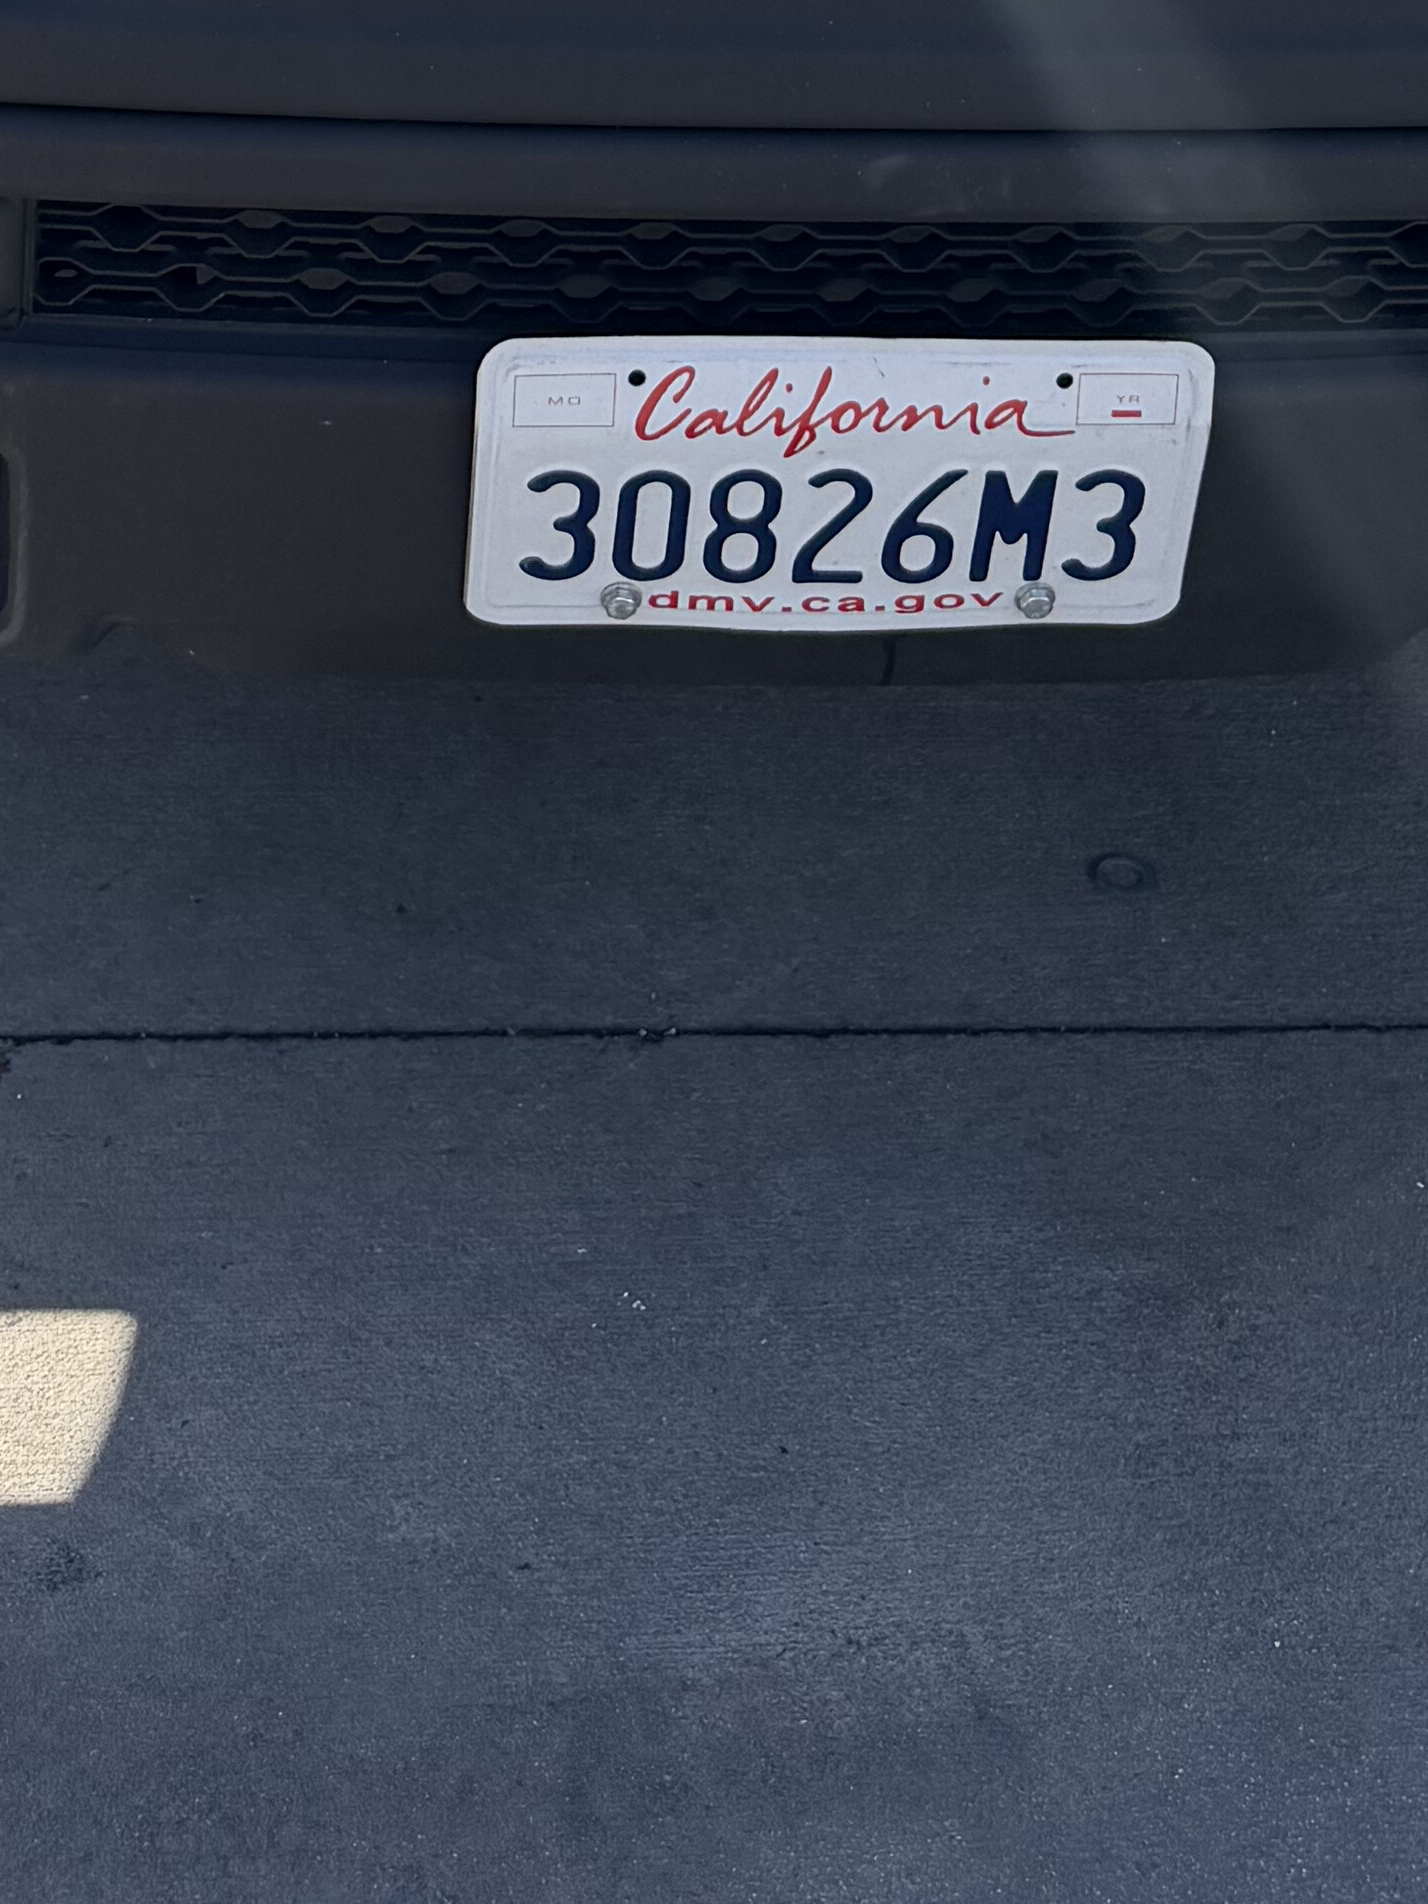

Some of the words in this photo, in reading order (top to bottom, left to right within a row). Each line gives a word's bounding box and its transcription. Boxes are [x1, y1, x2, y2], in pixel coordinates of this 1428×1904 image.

[547, 395, 582, 406] MO
[634, 364, 1077, 459] California
[1116, 393, 1142, 404] YR
[518, 467, 1147, 586] 30826M3
[647, 589, 1005, 615] dmv.ca.gov
